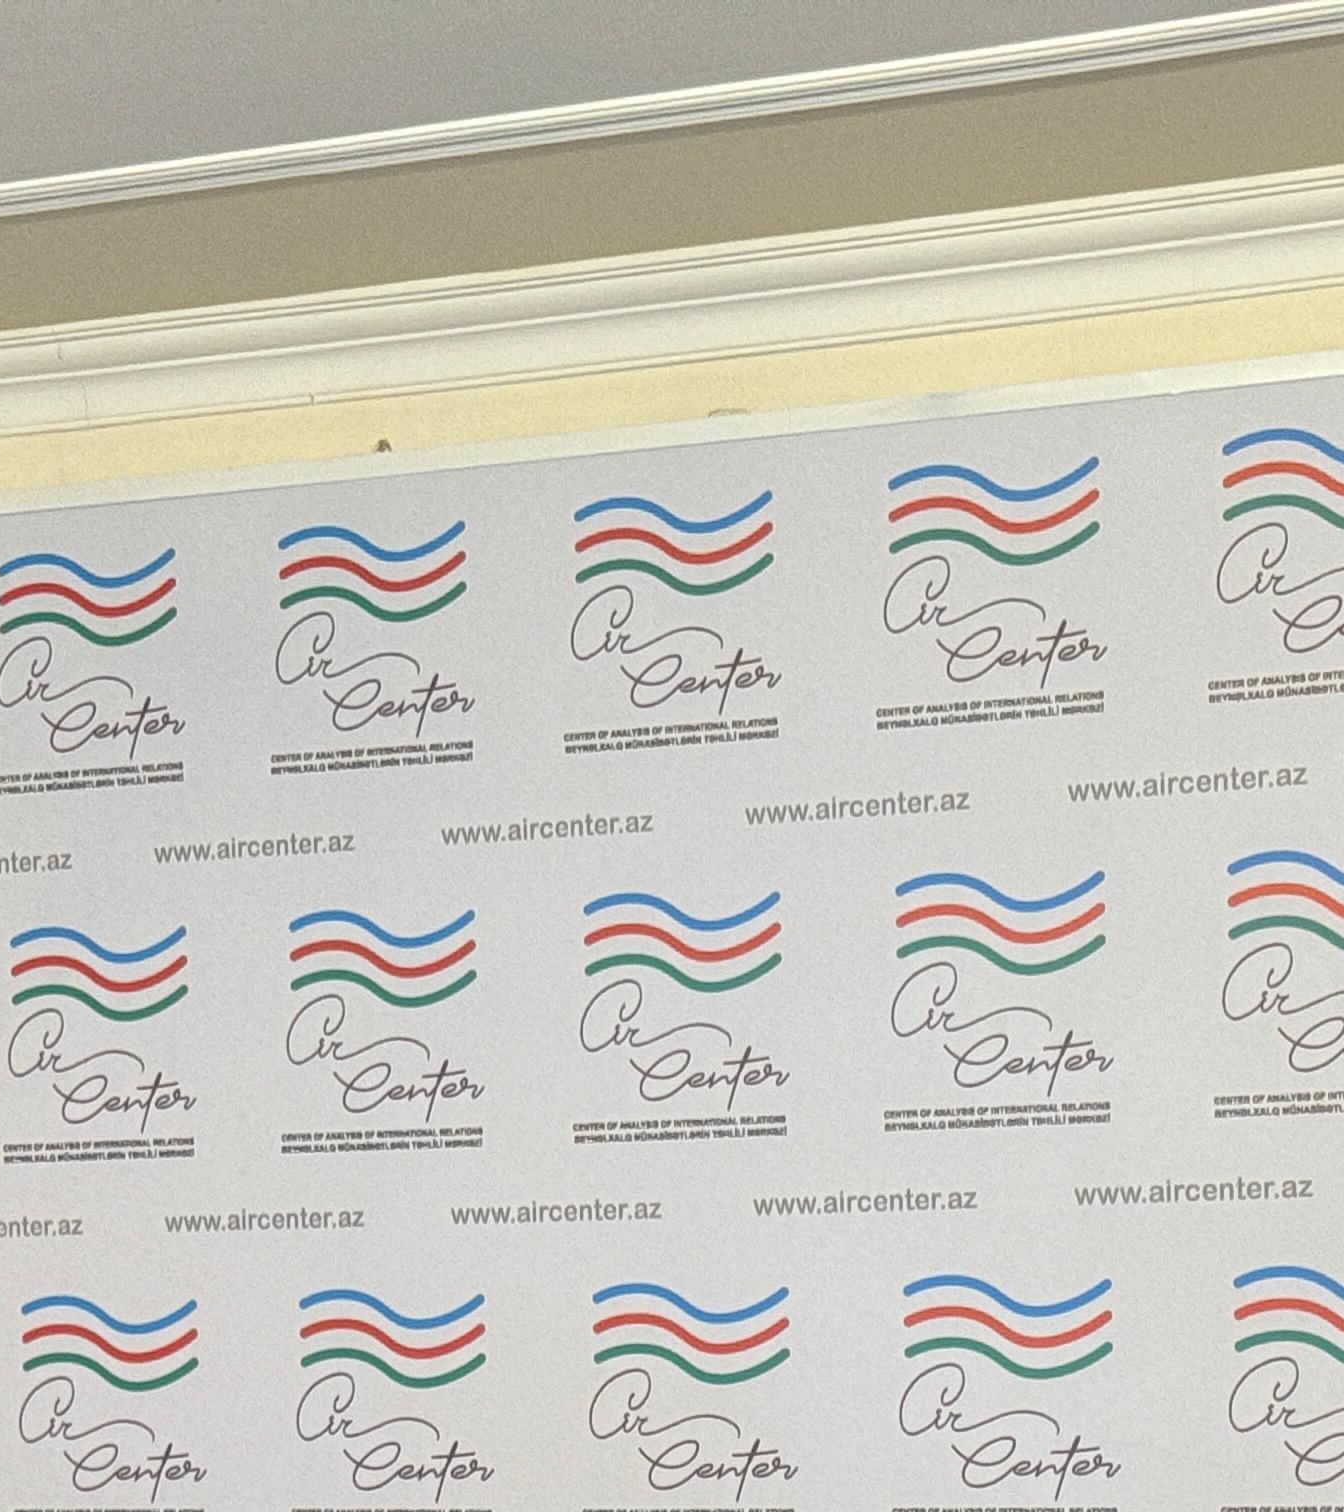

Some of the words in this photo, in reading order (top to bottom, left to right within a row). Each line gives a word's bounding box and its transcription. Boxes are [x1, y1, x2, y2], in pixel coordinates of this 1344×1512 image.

[936, 619, 1108, 690] Center
[620, 647, 782, 716] Center
[40, 696, 186, 760] Center
[745, 791, 970, 825] www.aircenter.az
[1068, 766, 1308, 802] www.aircenter.az
[154, 833, 356, 864] www.aircenter.az
[441, 813, 654, 845] www.aircenter.az
[943, 1029, 1114, 1098] Center
[333, 1059, 485, 1123] Center
[451, 1198, 662, 1225] www.aircenter.az
[753, 1188, 978, 1216] www.aircenter.az
[1074, 1176, 1314, 1206] www.aircenter.az
[164, 1207, 365, 1232] www.aircenter.az
[63, 1442, 207, 1504] Center
[638, 1438, 799, 1503] Center
[951, 1435, 1122, 1502] Center
